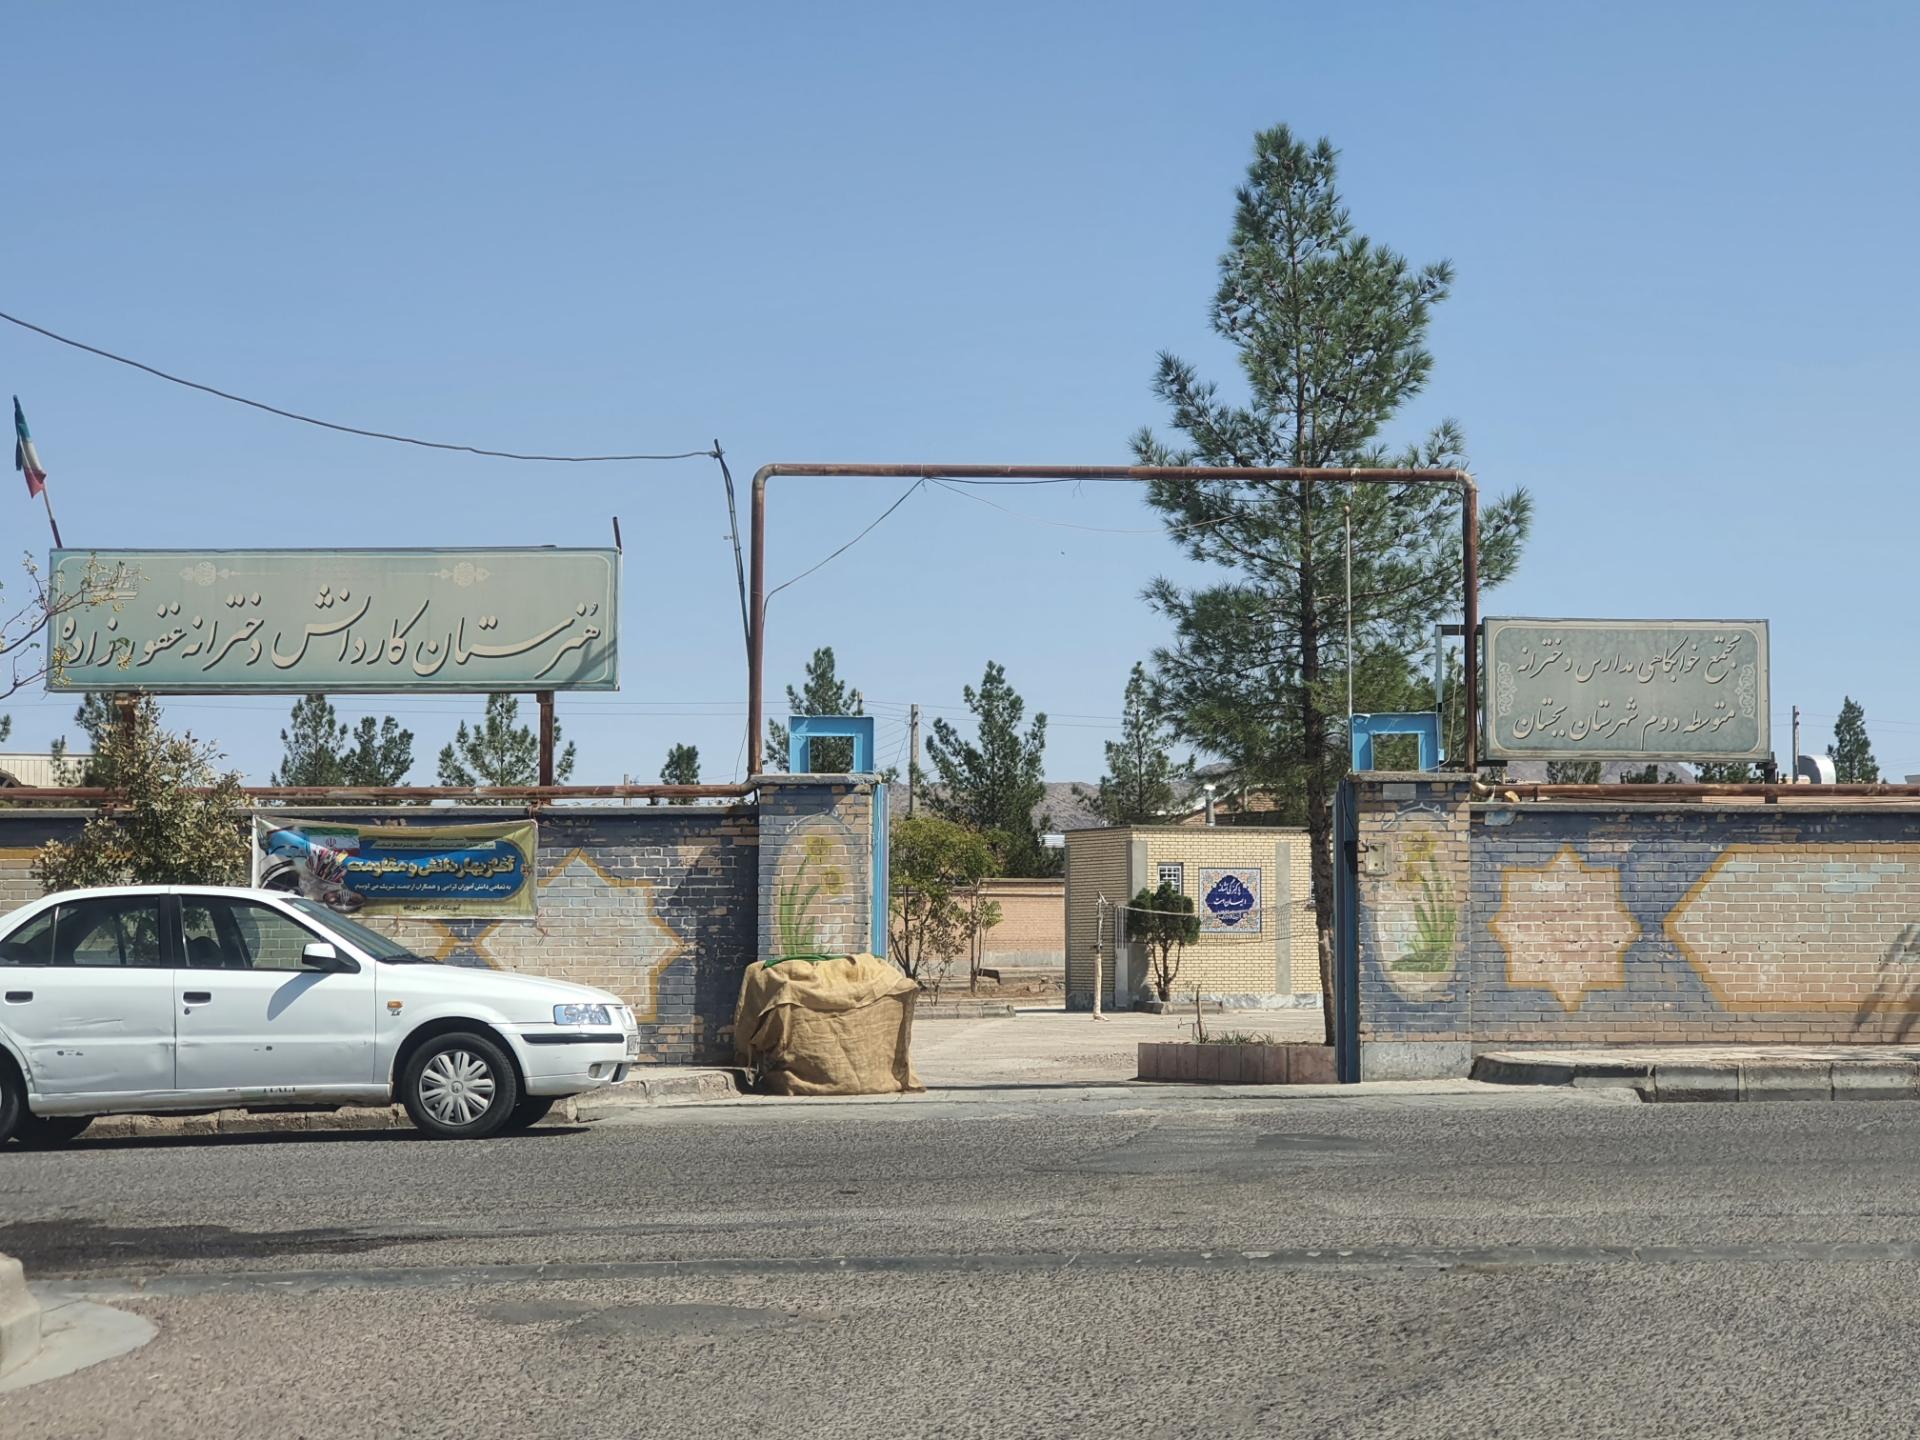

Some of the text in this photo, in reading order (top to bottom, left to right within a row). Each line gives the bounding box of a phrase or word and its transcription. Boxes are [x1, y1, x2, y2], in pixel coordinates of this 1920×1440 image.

[181, 592, 265, 672] دخترانه
[271, 583, 429, 670] کاردانش
[1517, 634, 1741, 684] مجتمع خوابگاهی مدارس دخترانه
[1512, 696, 1735, 751] متوسطه دوم شهرستان بجستان
[347, 855, 515, 879] آغاز بهار دانش و مقاومت
